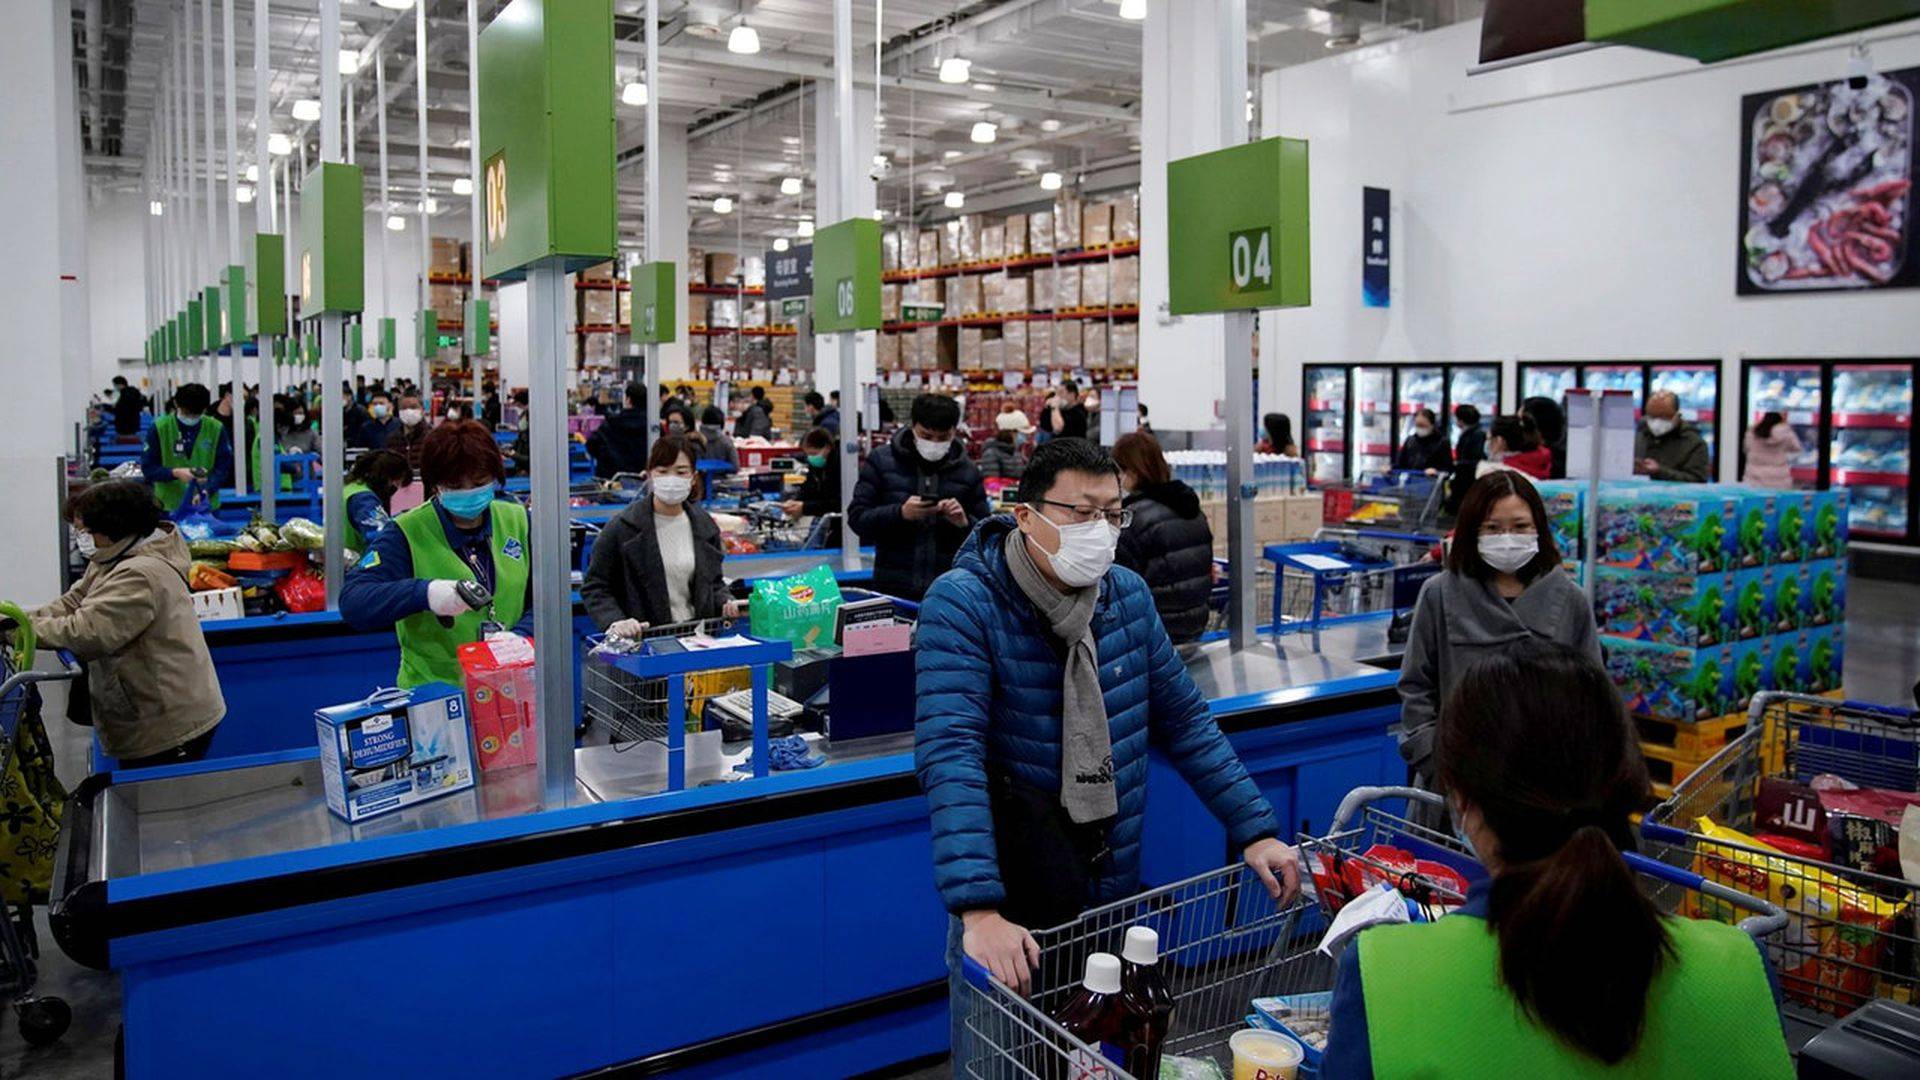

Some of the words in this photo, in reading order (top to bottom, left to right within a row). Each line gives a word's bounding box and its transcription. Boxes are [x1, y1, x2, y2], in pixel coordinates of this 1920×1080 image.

[486, 158, 507, 243] 03
[1232, 231, 1271, 288] 04
[837, 280, 854, 318] 06
[449, 700, 459, 712] 8
[364, 730, 395, 747] STRONG
